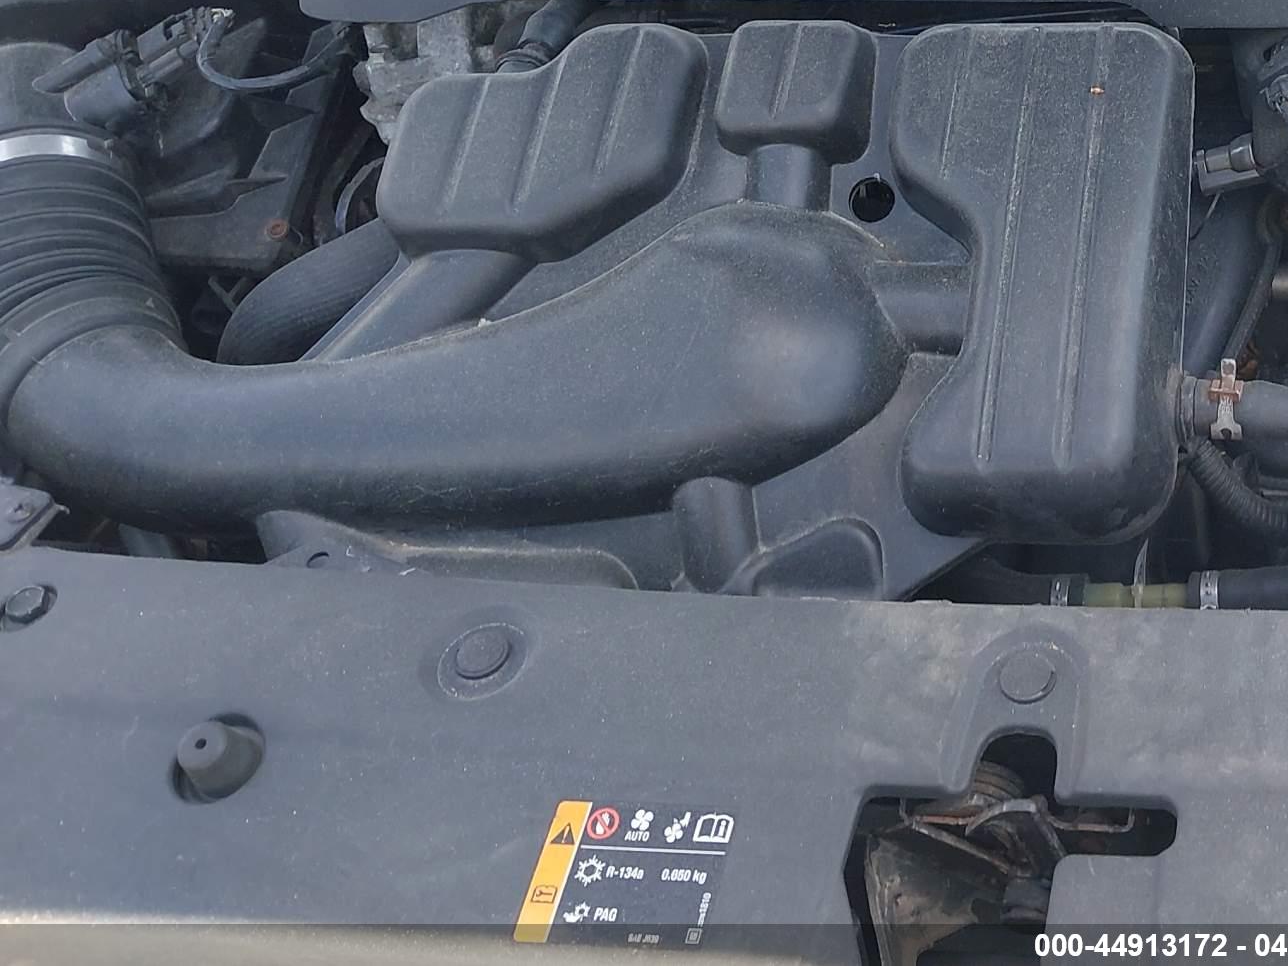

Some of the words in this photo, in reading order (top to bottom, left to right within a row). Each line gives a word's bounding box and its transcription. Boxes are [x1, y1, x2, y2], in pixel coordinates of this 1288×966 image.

[624, 831, 650, 842] AUTO
[606, 865, 644, 880] R-134a
[692, 869, 707, 885] kg
[593, 907, 618, 922] PAG
